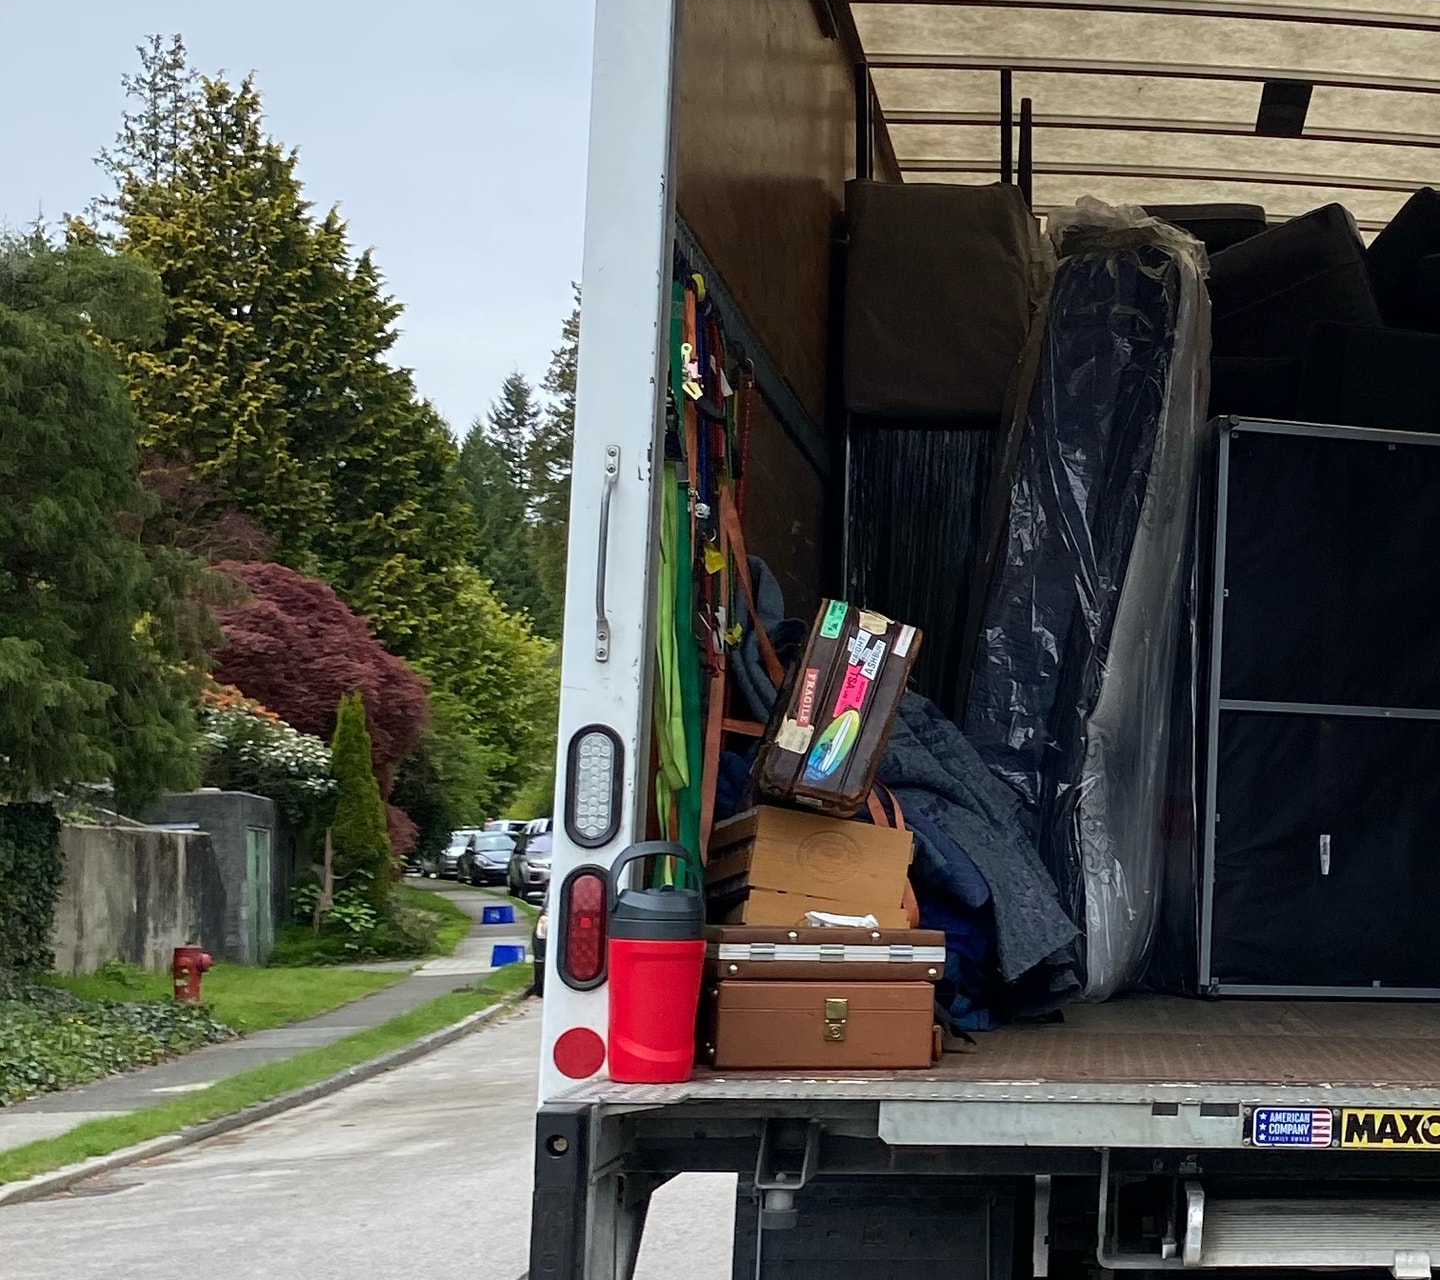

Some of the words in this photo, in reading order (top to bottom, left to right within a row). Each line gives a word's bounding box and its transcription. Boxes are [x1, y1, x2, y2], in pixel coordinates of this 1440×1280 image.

[845, 669, 861, 690] TSA
[799, 672, 818, 724] FRAGILE
[1269, 1112, 1311, 1123] AMERICAN
[1268, 1123, 1311, 1135] COMPANY
